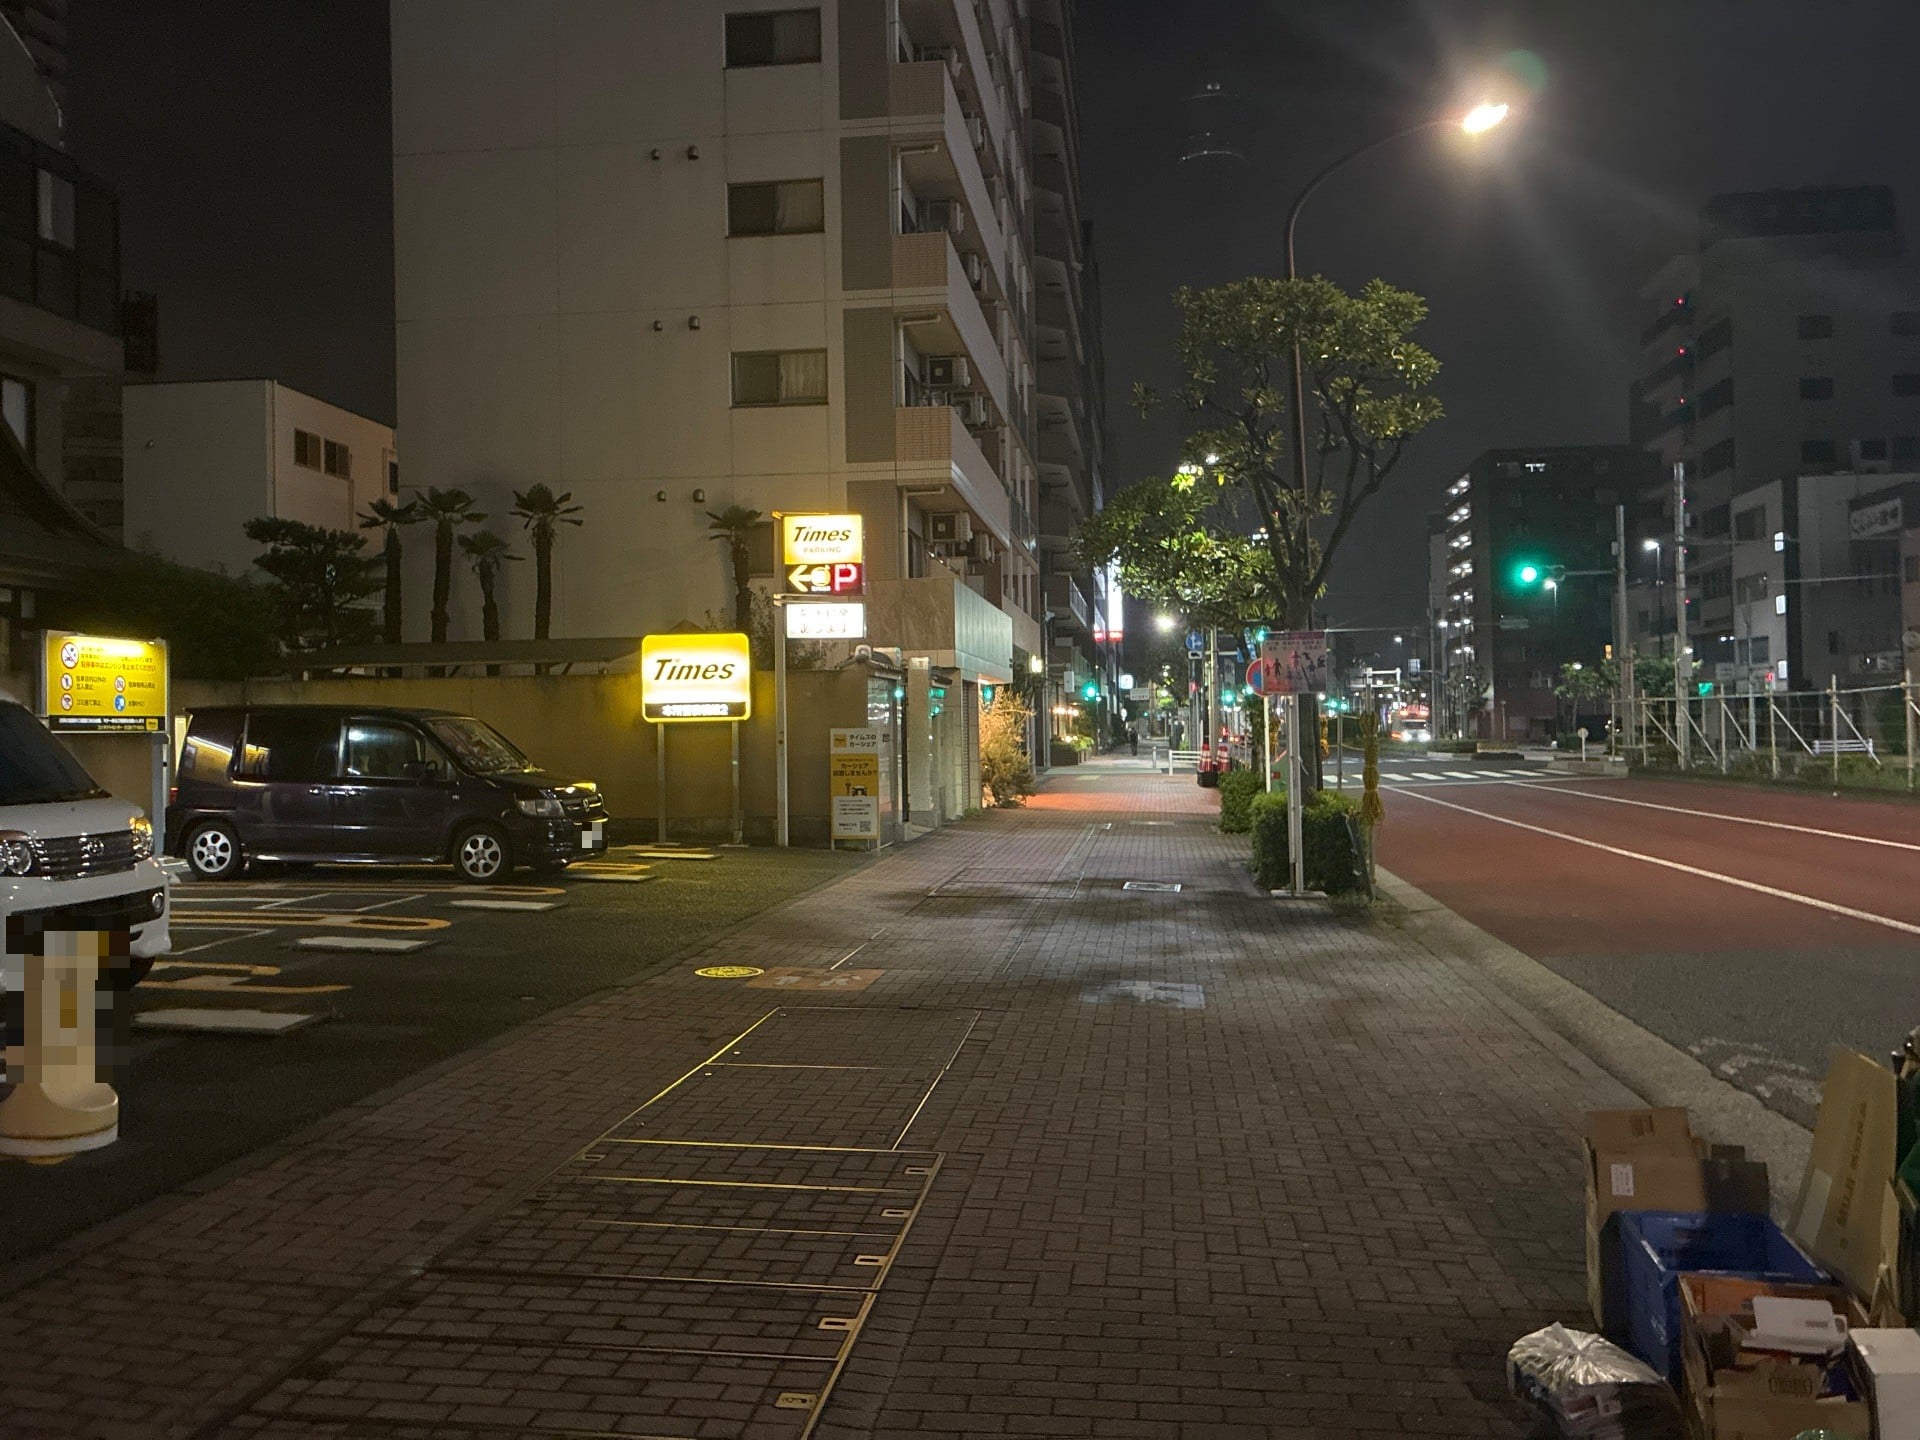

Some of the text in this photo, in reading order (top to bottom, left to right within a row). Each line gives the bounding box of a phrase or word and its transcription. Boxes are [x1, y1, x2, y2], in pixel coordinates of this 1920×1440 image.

[793, 526, 852, 542] Times
[834, 564, 857, 592] P
[654, 658, 736, 681] Times
[849, 733, 877, 741] タイムスの
